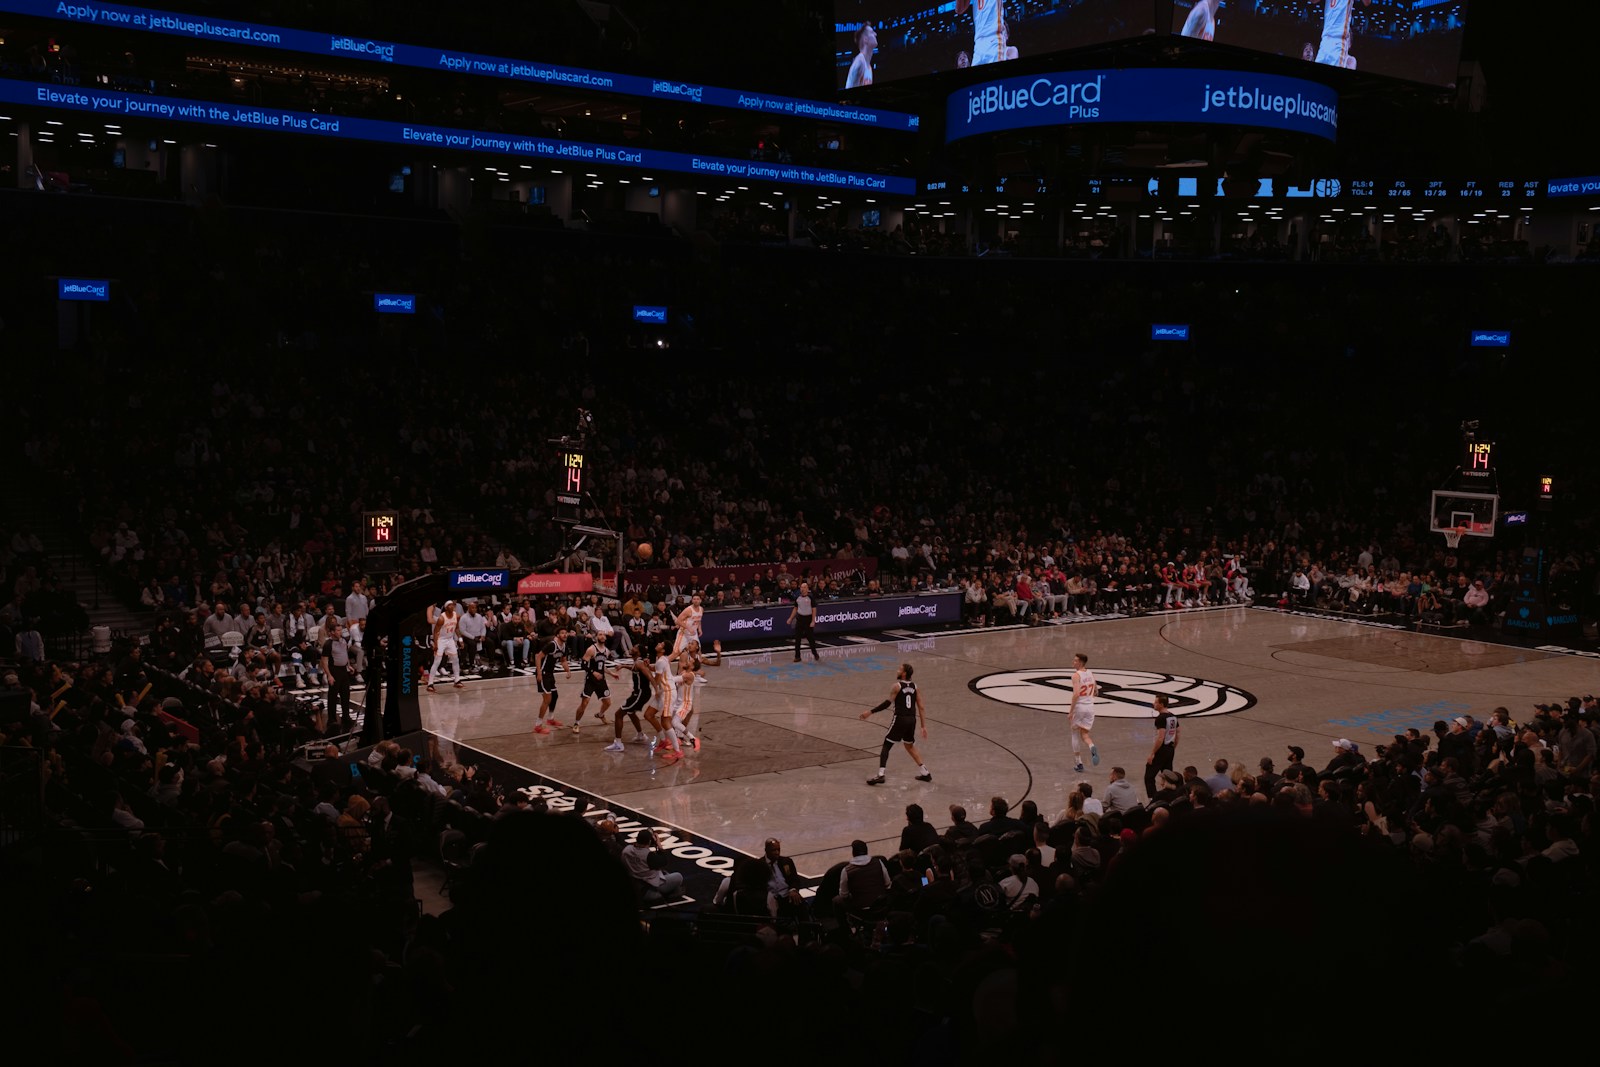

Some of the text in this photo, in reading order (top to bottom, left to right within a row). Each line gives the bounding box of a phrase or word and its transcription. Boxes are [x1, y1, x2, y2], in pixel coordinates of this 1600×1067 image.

[57, 1, 281, 44] Apply now at jetbluepluscard.com
[331, 36, 394, 56] jetBlueCard
[439, 54, 613, 87] Apply now at jetbluepluscard.com
[652, 80, 702, 97] jetBlueCard
[967, 75, 1101, 123] jetBlueCard
[37, 87, 339, 132] Elevate your journey with the JetBlue Plus Card
[738, 94, 877, 122] Apply now at jetbluepluscard.com
[1069, 105, 1100, 118] Plus
[403, 127, 642, 163] Elevate your journey with the JetBlue Plus Card
[692, 158, 886, 188] Elevate your journey with the JetBlue Plus Card
[1469, 443, 1490, 453] 11:24
[564, 453, 583, 468] 11:24
[1473, 453, 1488, 469] 14
[567, 468, 580, 492] 14
[371, 516, 393, 528] 11:24
[376, 528, 389, 541] 14
[457, 573, 502, 584] jetBlueCard
[898, 604, 937, 617] jetBlueCard
[729, 617, 773, 631] jetBlueCard
[402, 647, 413, 696] BARCLAYS
[1080, 683, 1094, 697] 27
